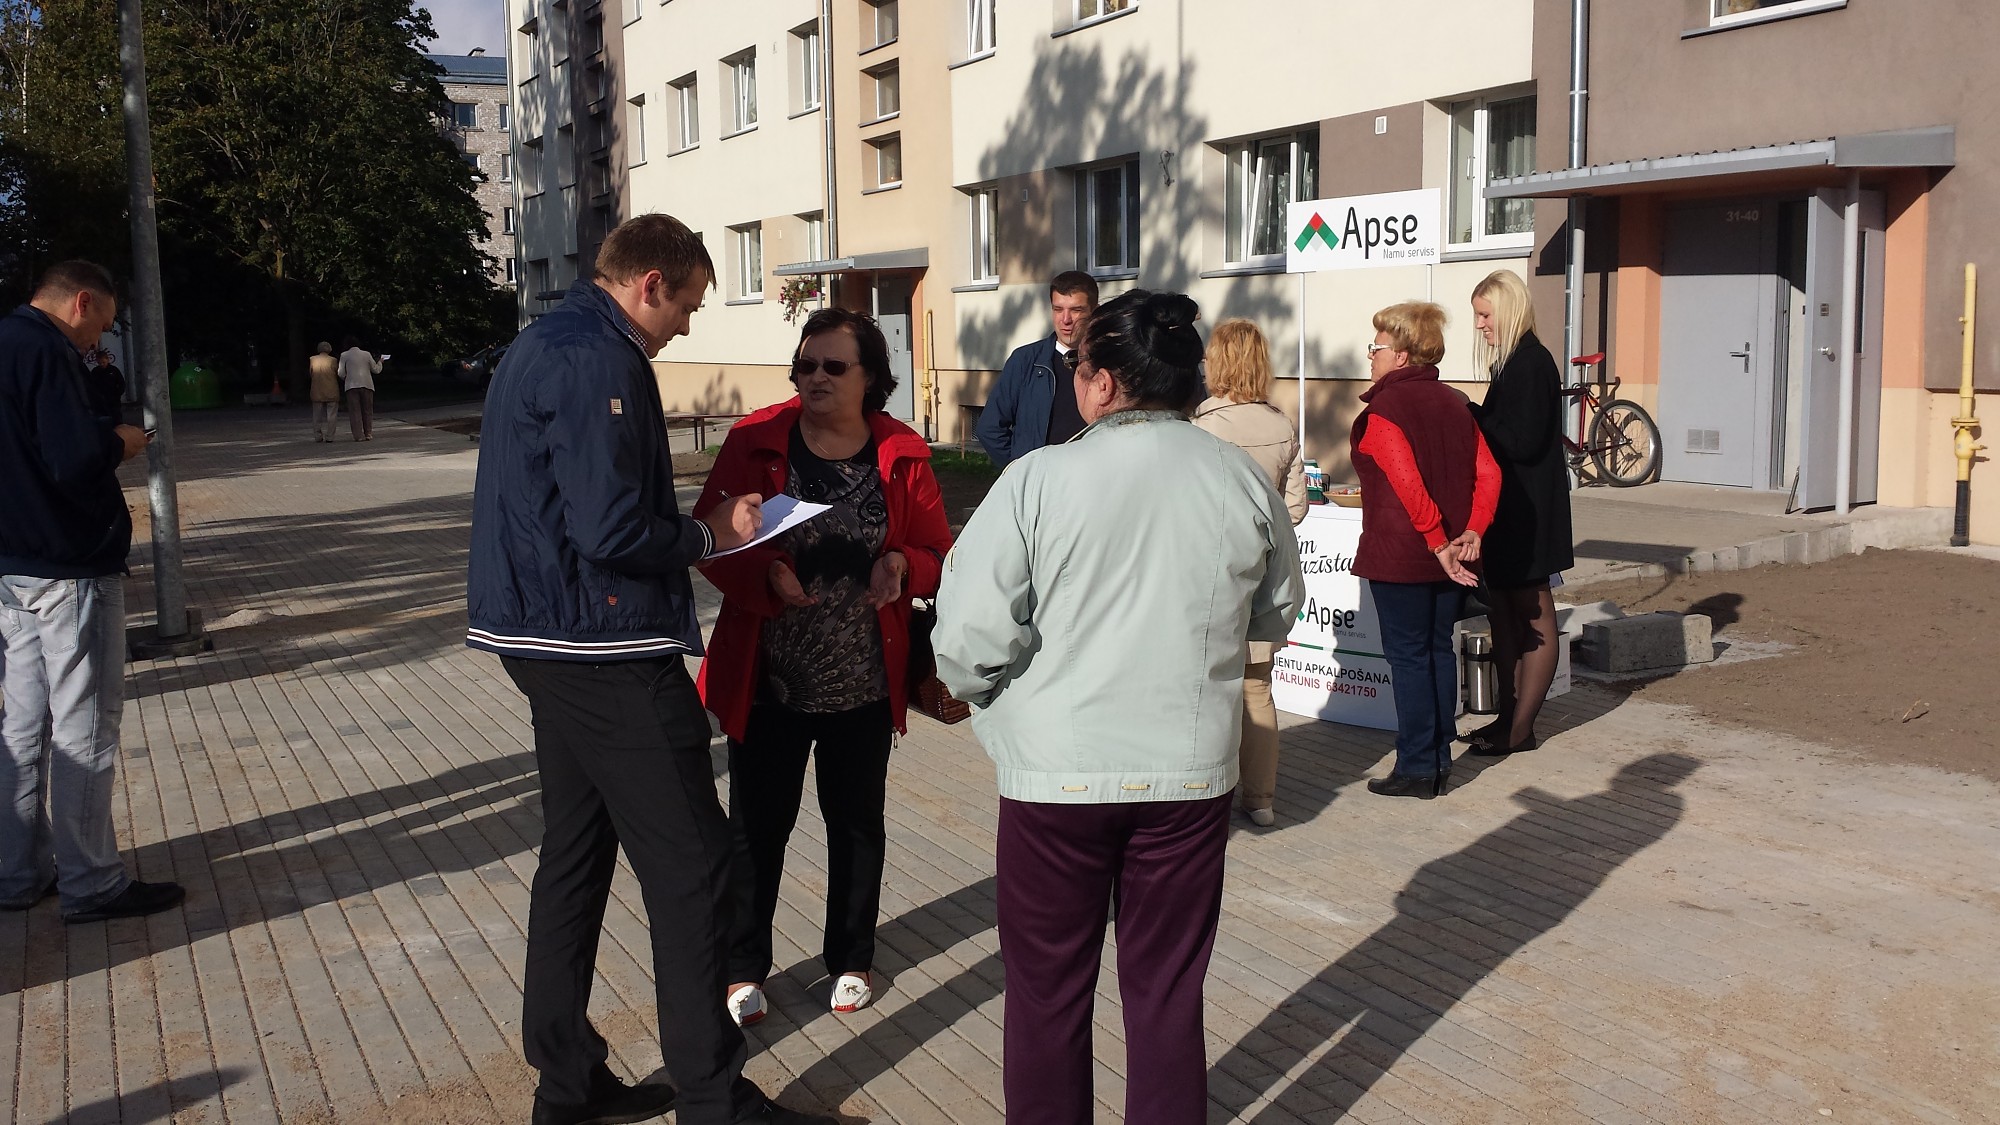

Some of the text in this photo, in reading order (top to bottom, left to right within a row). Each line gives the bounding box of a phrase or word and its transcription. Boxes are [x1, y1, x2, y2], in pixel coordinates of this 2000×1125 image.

[1726, 209, 1759, 222] 31-40
[1341, 206, 1418, 260] Apse
[1383, 247, 1435, 259] Namu serviss
[1300, 552, 1353, 575] azīsta
[1306, 596, 1355, 633] Apse
[1274, 656, 1391, 685] IENTU APKALPOŠANA
[1274, 669, 1377, 698] TĀLRUNIS 63421750
